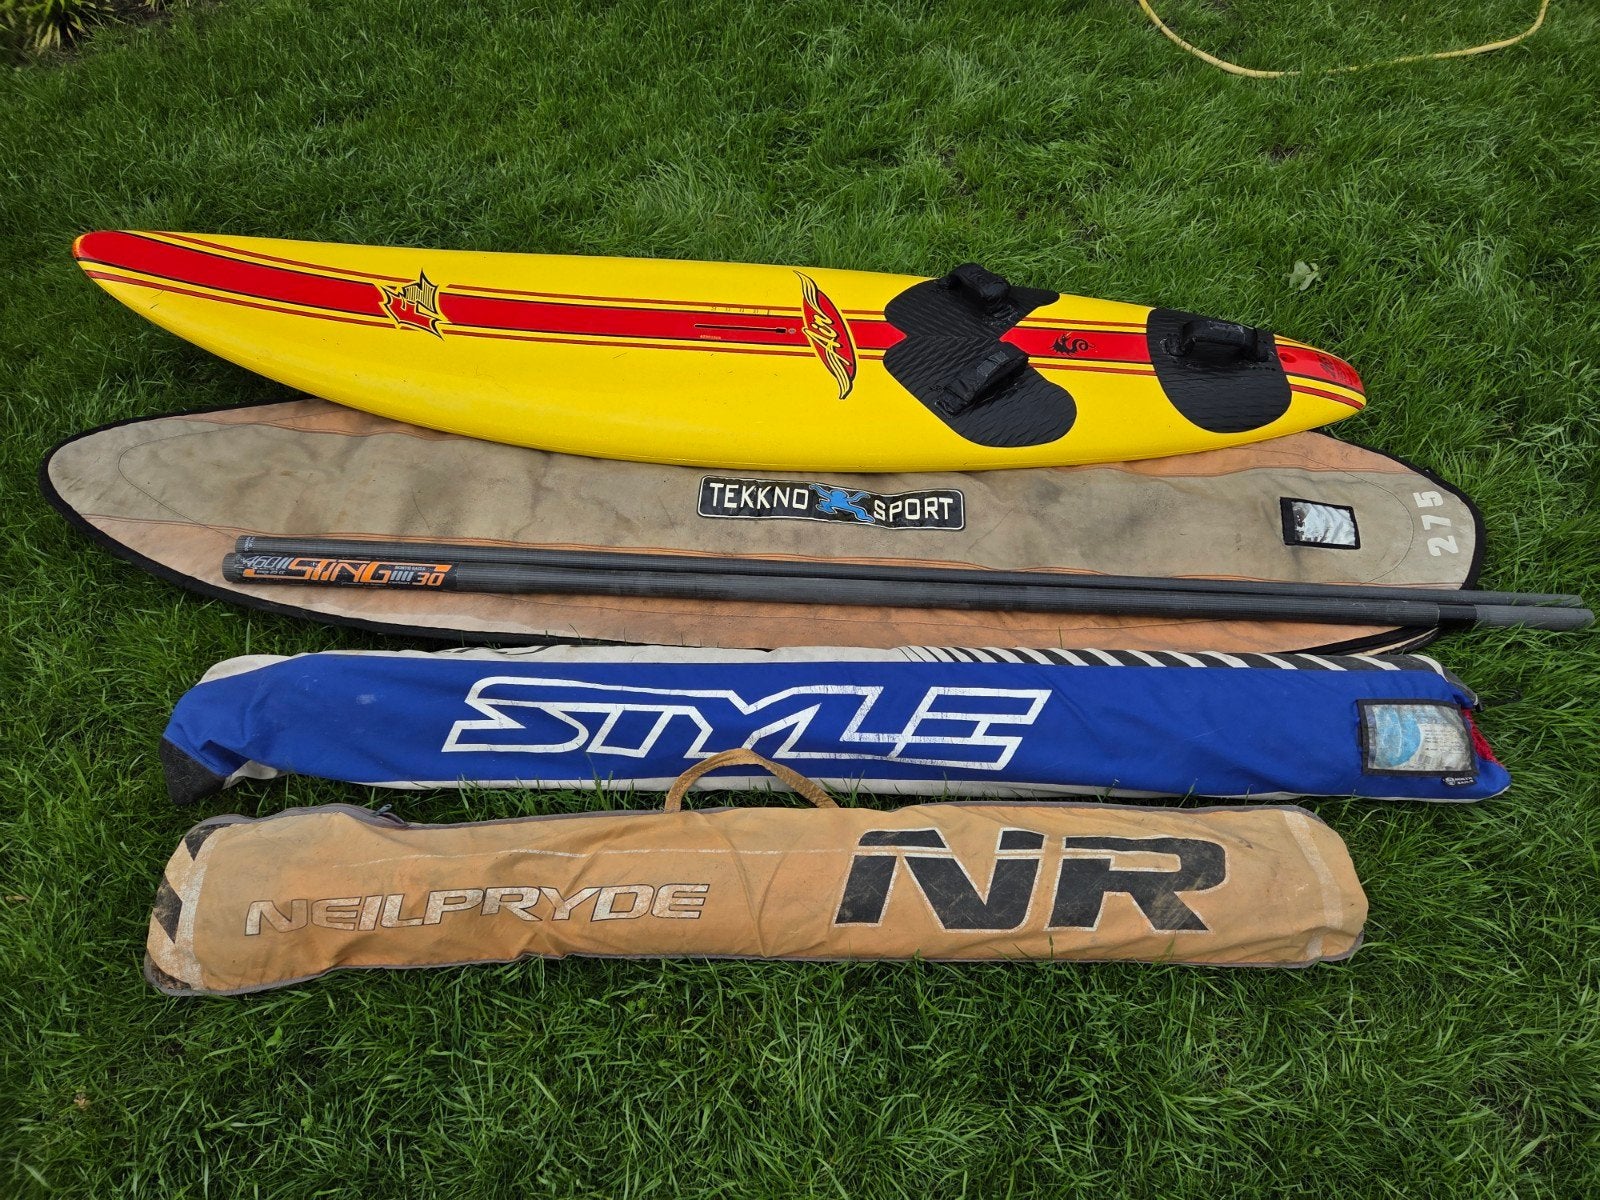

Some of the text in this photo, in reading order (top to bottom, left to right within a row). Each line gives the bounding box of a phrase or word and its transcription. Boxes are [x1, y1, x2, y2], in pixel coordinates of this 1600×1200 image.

[802, 313, 853, 367] Air
[709, 482, 954, 522] TEKKNO SPORT
[1412, 490, 1459, 557] 275
[412, 571, 446, 587] 30
[441, 676, 1052, 770] STYLE
[833, 827, 1230, 934] NR
[244, 882, 710, 937] NEILPRYDE
